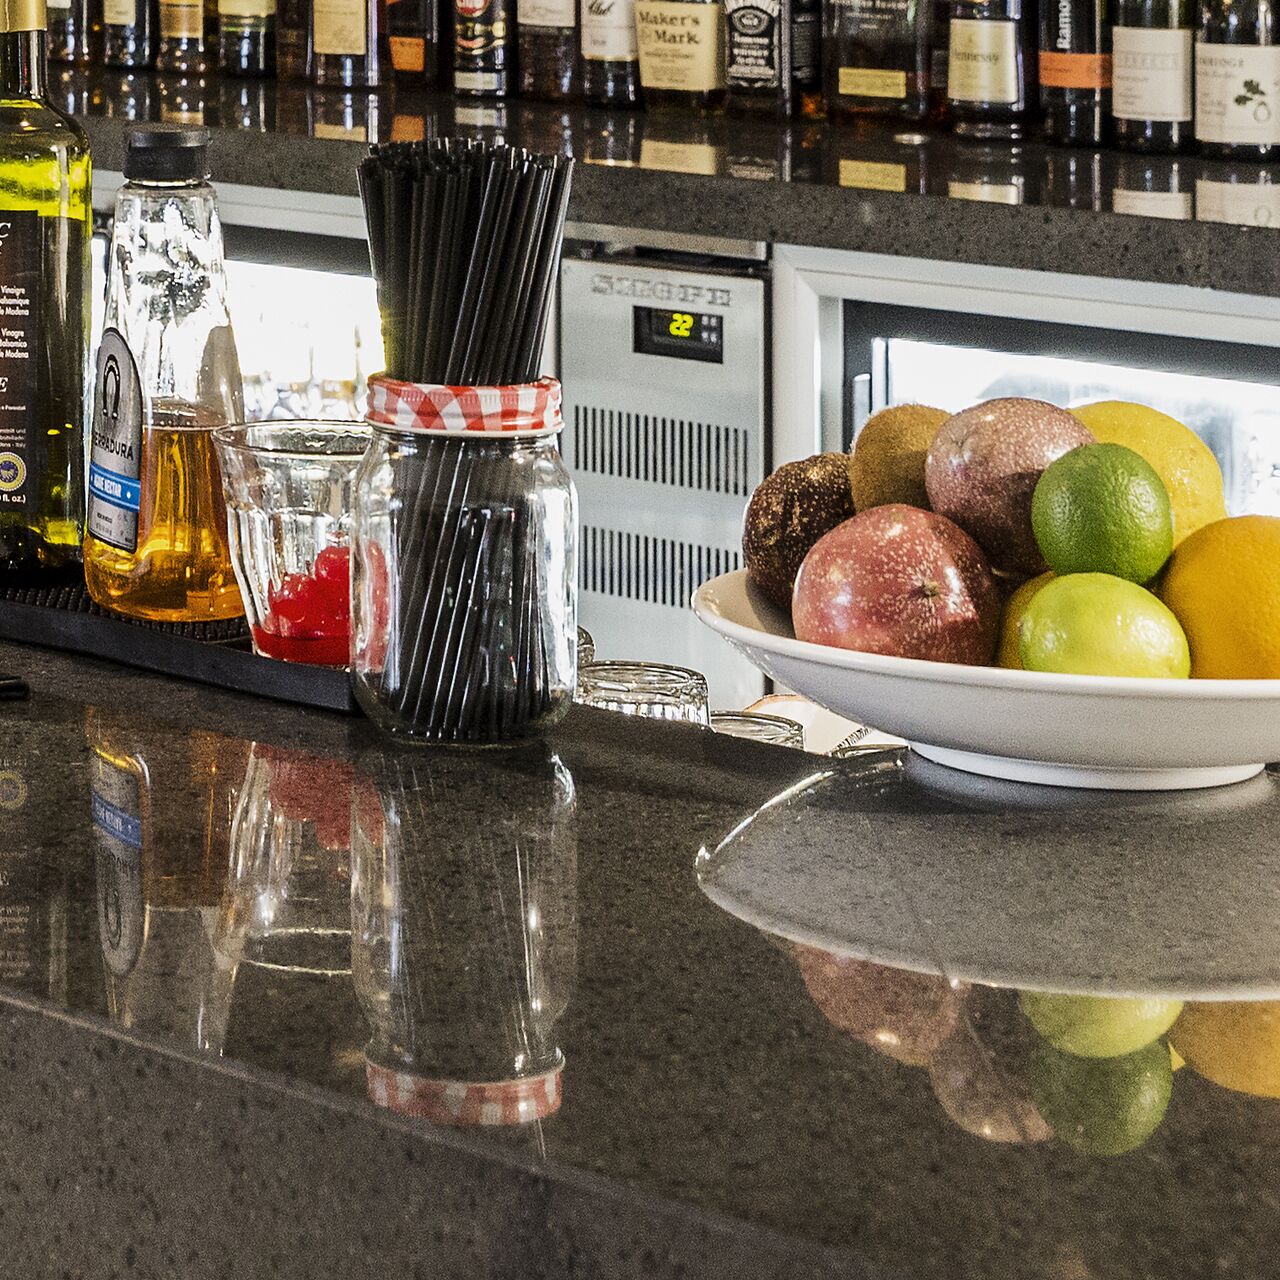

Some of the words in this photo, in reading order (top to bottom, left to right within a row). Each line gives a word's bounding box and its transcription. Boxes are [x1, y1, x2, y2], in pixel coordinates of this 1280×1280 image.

[639, 10, 700, 26] Maker's
[654, 30, 700, 45] Mark
[0, 284, 26, 299] Vinaigre
[5, 307, 30, 316] Modena
[1, 327, 25, 339] Vinagre
[5, 350, 29, 359] Modena
